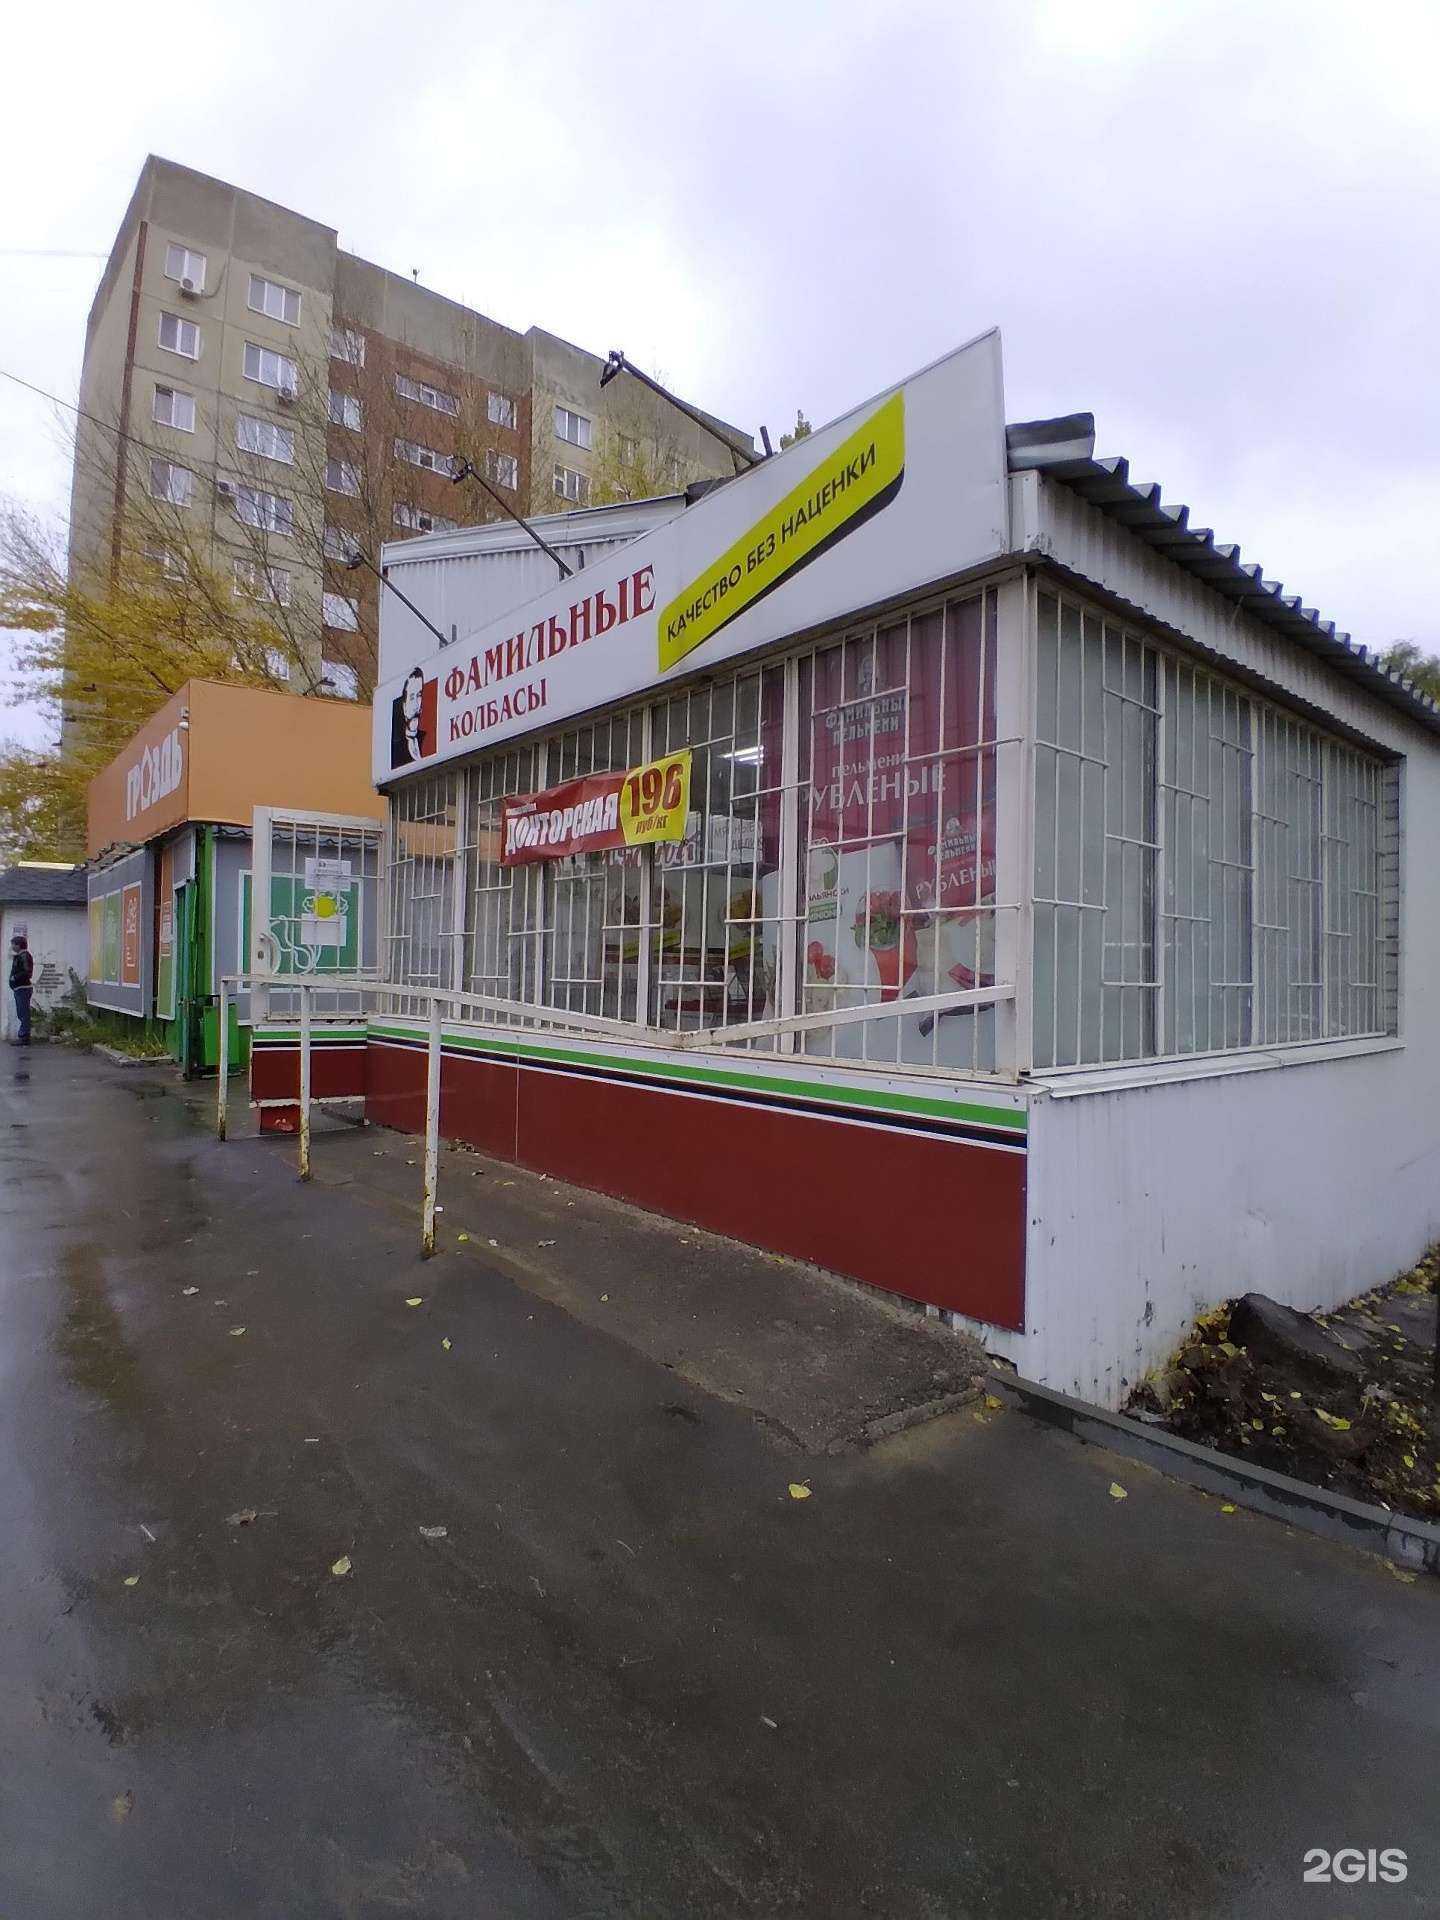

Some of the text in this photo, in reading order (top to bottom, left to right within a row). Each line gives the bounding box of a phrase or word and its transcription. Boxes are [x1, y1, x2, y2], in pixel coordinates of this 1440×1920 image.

[667, 443, 876, 642] КАЧЕСТВО БЕЗ НАЦЕНКИ
[444, 564, 656, 701] ФАМИЛЬНЫЕ
[449, 678, 547, 742] КОЛБАСЫ
[826, 696, 908, 729] ФАМИЛЬНЫ
[127, 728, 182, 821] ГРОЗДЬ
[627, 764, 683, 817] 196
[505, 792, 618, 857] ДОКТОРСКАЯ
